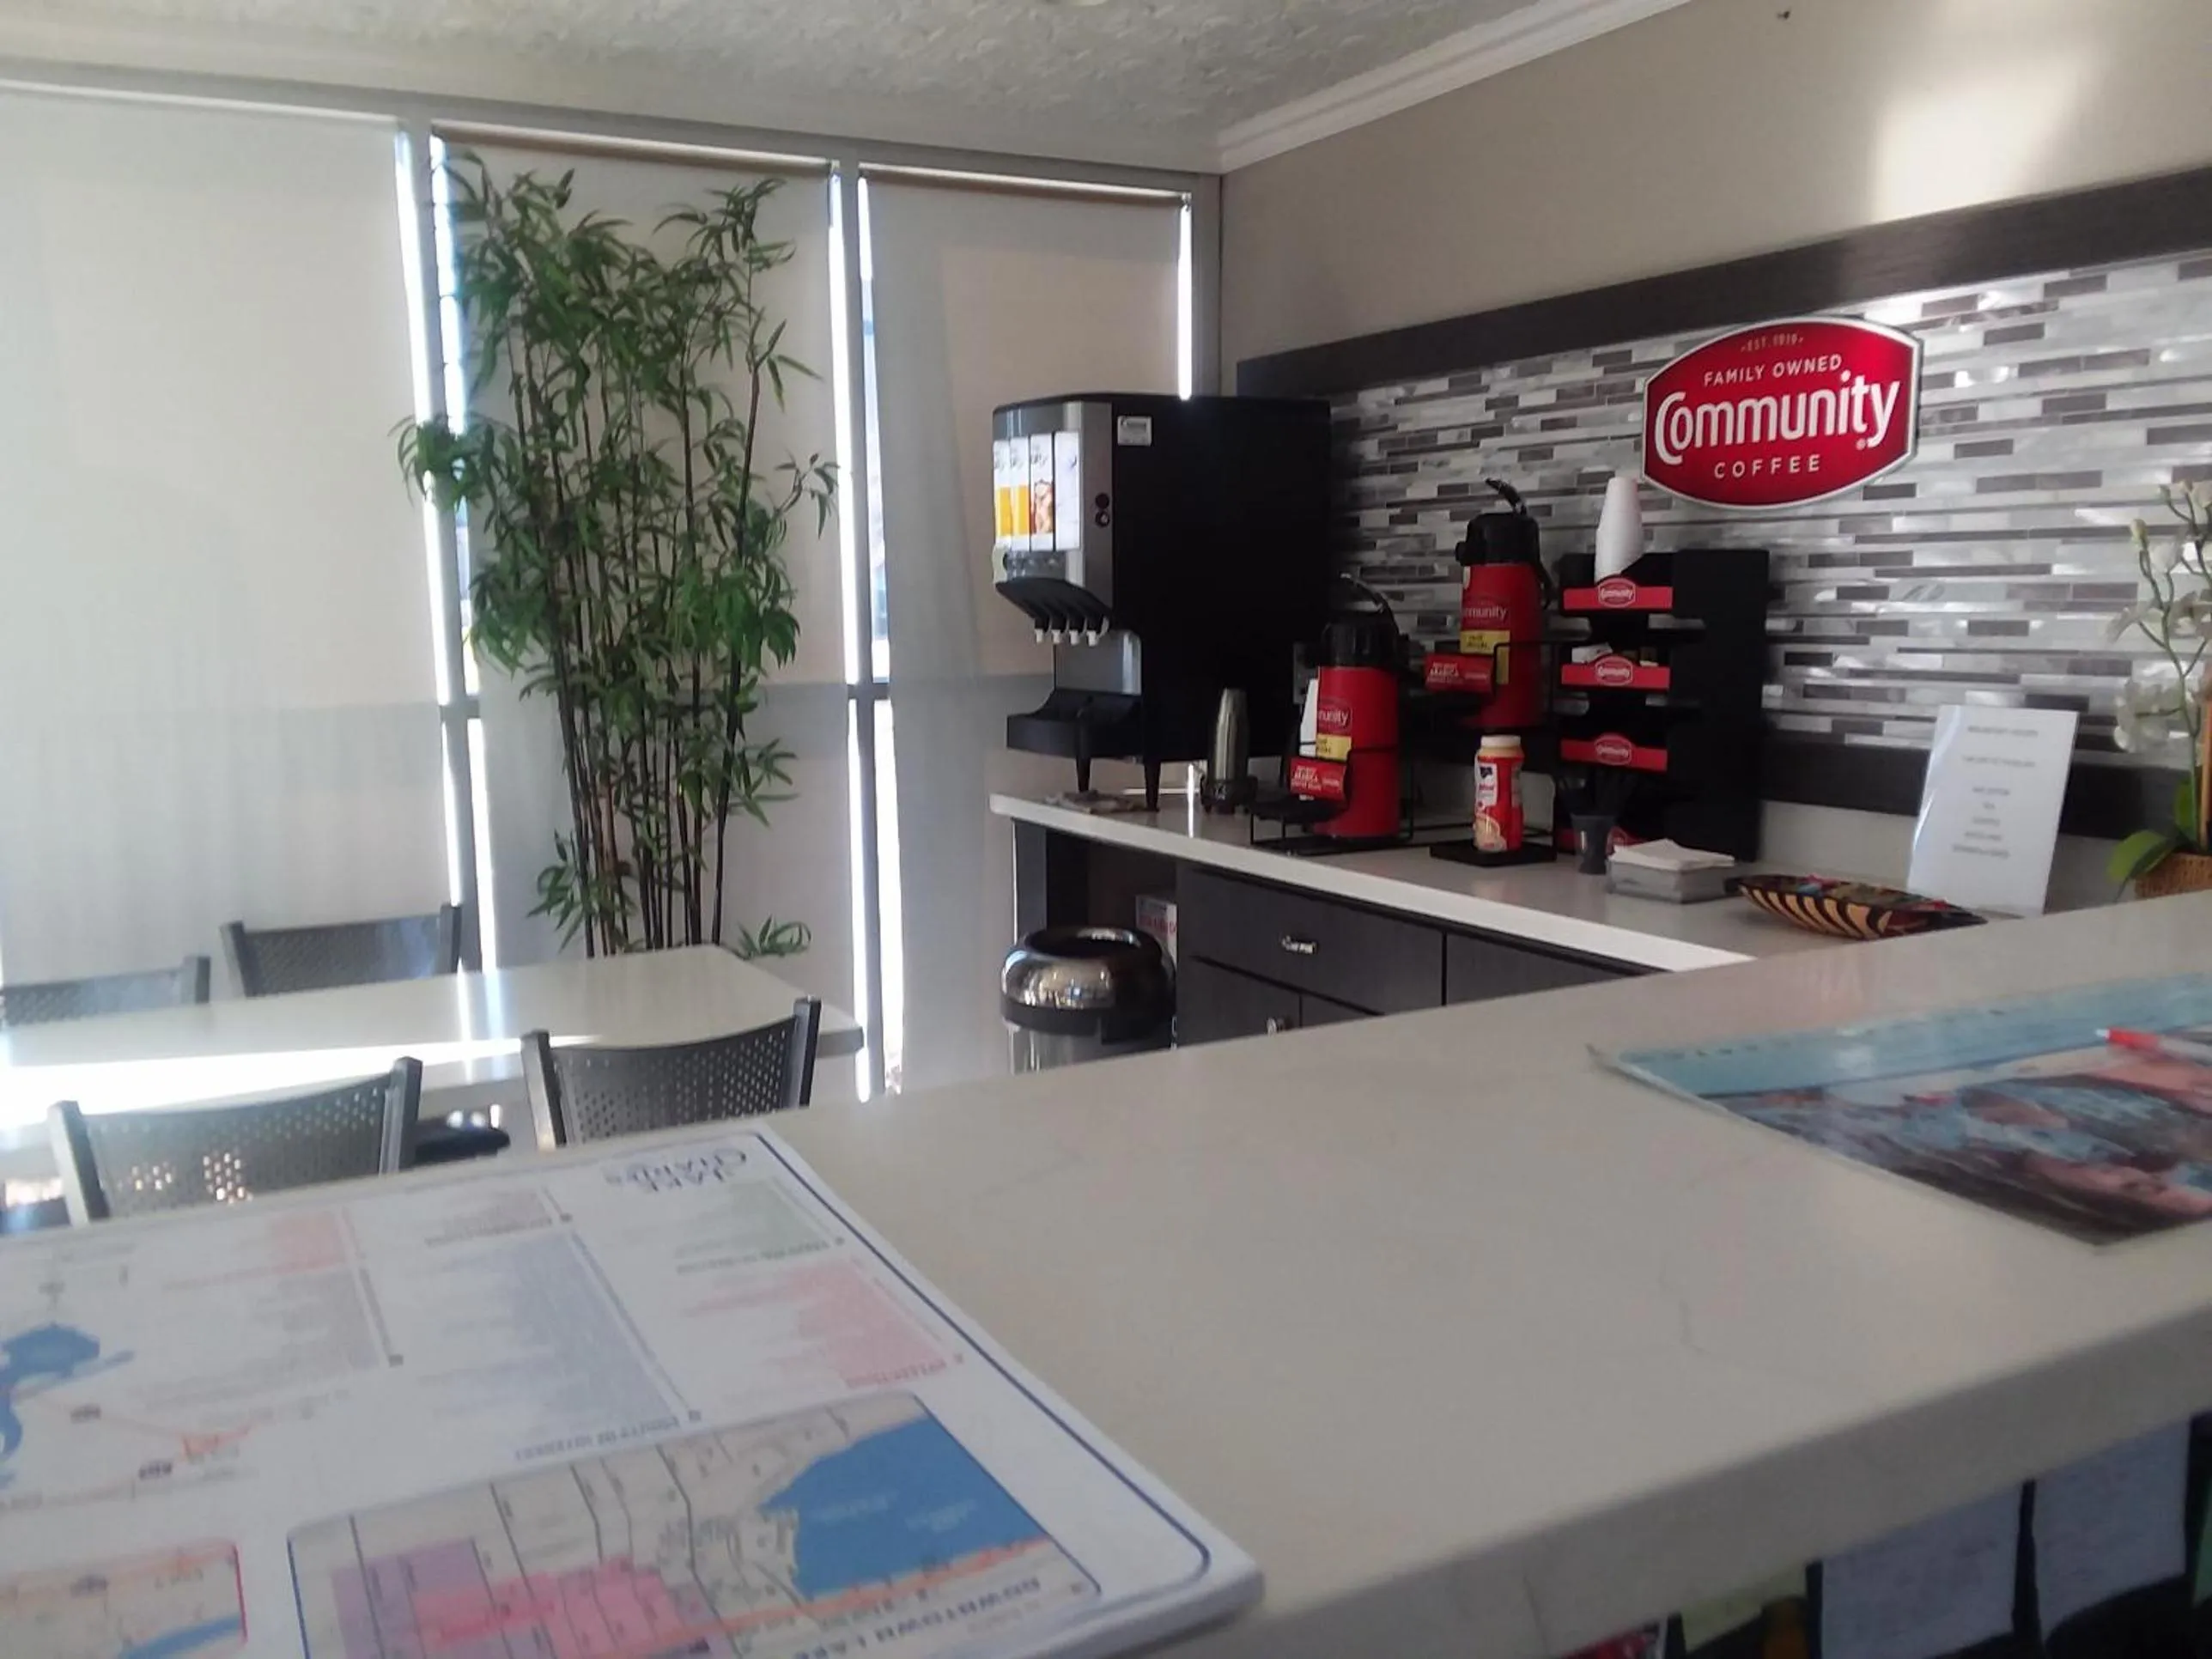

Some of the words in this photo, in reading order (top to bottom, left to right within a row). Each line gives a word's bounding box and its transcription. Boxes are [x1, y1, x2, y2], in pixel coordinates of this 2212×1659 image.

[1705, 365, 1764, 387] FAMILY
[1772, 353, 1842, 378] OWNED
[1655, 370, 1900, 465] Community
[1714, 453, 1821, 478] COFFEE
